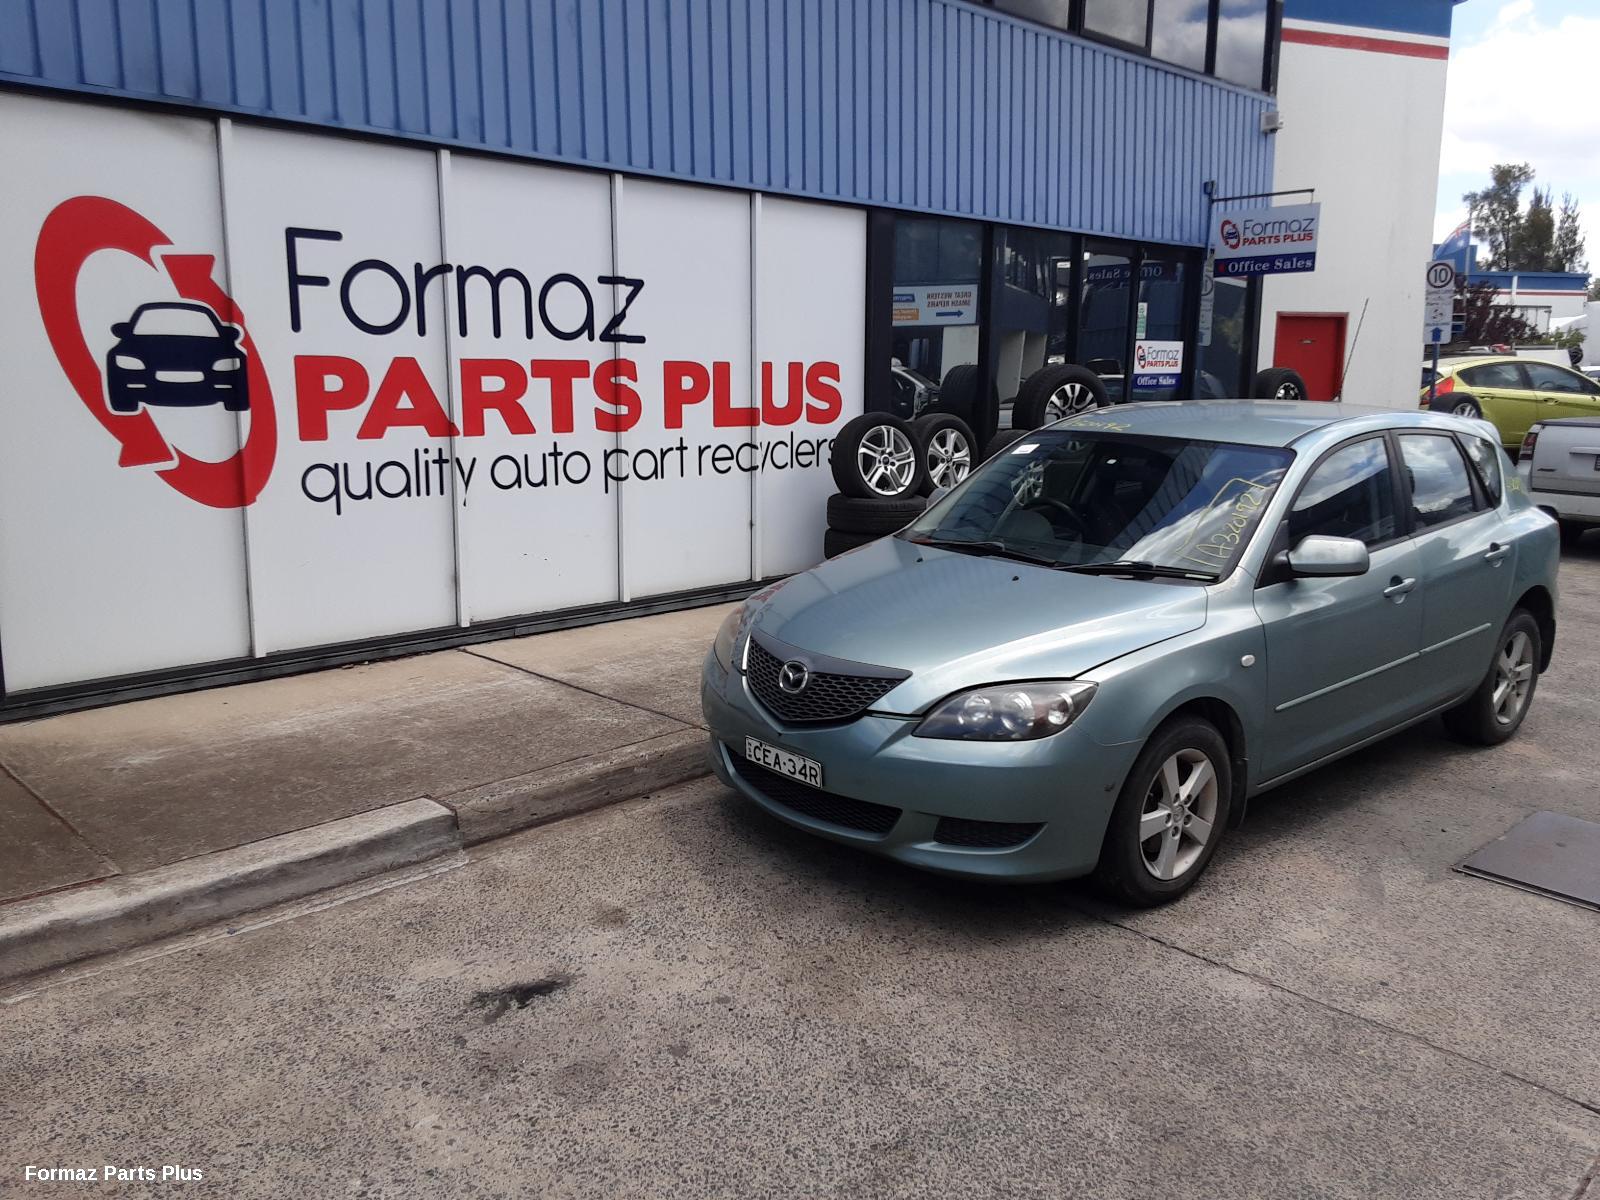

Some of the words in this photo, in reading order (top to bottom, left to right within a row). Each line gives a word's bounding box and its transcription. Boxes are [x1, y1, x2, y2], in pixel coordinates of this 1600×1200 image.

[1243, 218, 1315, 236] Formaz
[1242, 235, 1281, 246] PARTS
[1283, 233, 1313, 243] PLUS
[1228, 261, 1270, 273] Office
[1274, 258, 1312, 270] Sales
[1434, 268, 1448, 283] 10
[285, 227, 646, 343] Formaz
[1147, 346, 1180, 361] Formaz
[1137, 376, 1157, 386] Office
[1158, 376, 1176, 385] Sales
[294, 355, 642, 441] PARTS
[663, 360, 842, 429] PLUS
[301, 447, 477, 515] quality
[490, 441, 592, 489] auto
[603, 436, 688, 494] part
